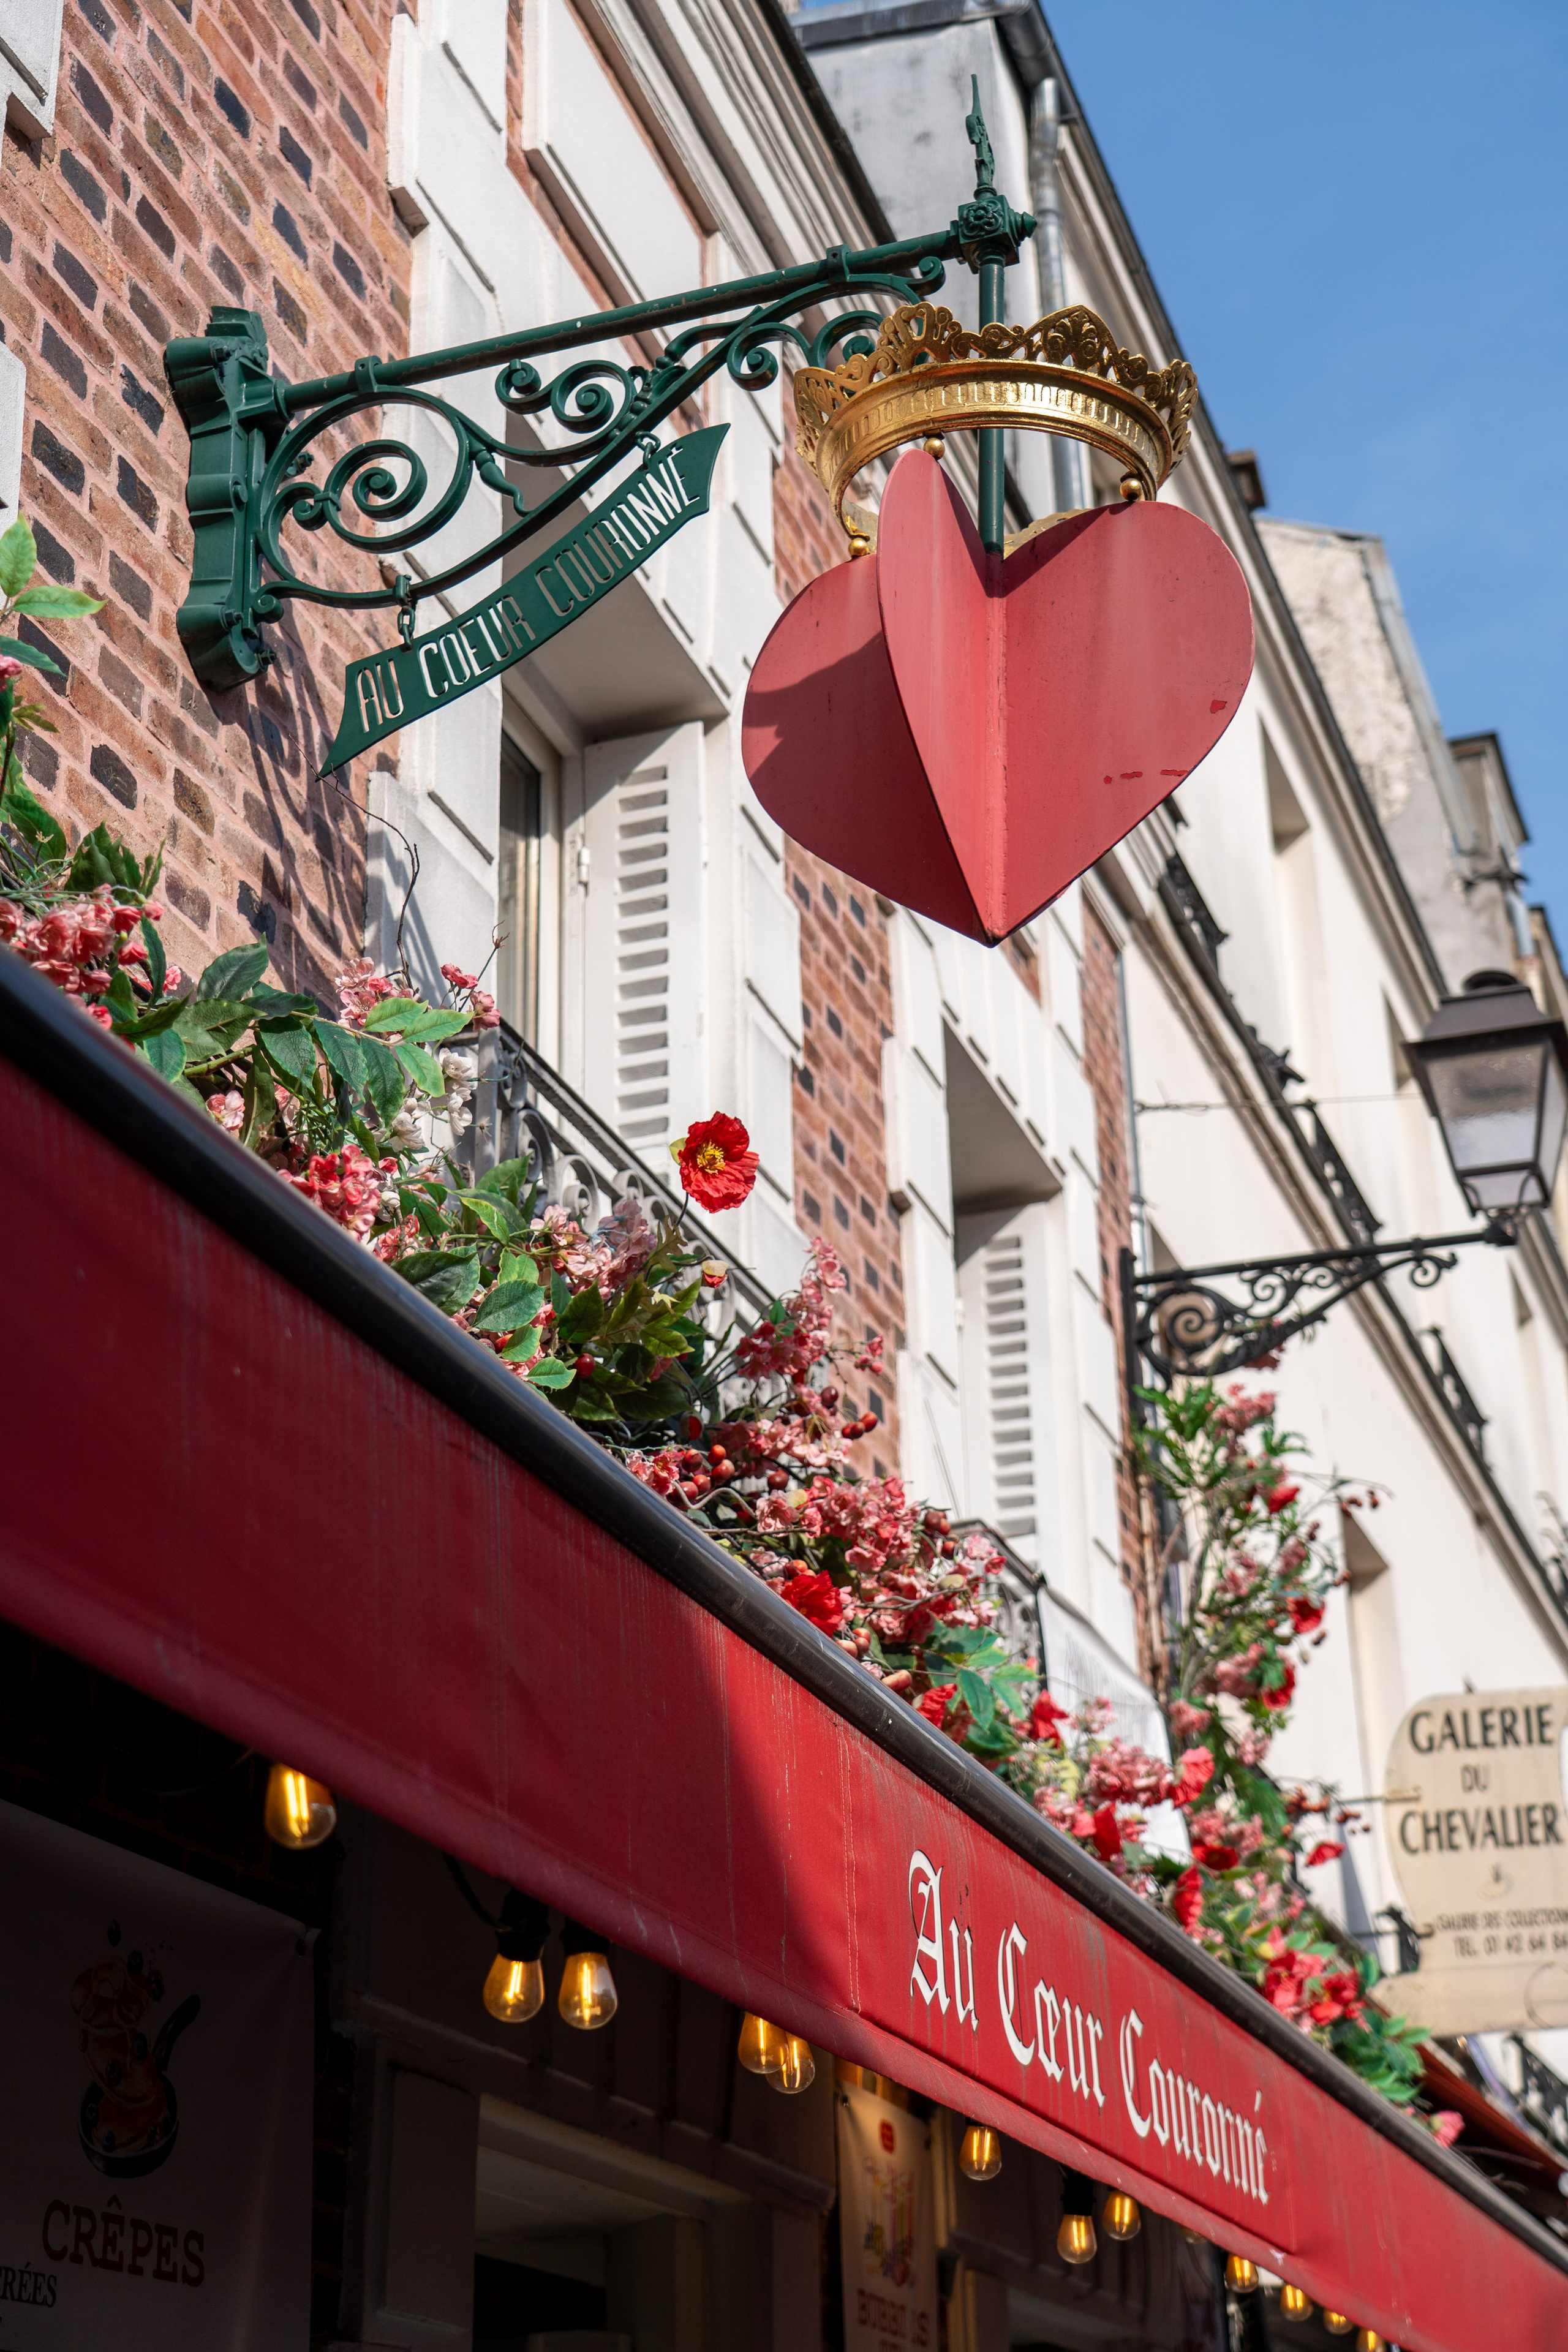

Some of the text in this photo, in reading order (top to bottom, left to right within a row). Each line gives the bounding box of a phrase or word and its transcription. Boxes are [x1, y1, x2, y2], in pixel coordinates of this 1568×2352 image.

[355, 658, 404, 733] AU
[418, 595, 536, 698] COEUR
[1409, 1703, 1555, 1754] GALERIE
[1461, 1763, 1489, 1792] DU
[1399, 1802, 1565, 1855] CHEVALIER
[908, 1849, 979, 2032] Au
[1119, 2007, 1270, 2206] Couronné
[42, 2193, 205, 2287] CRÊPES
[0, 2262, 56, 2307] RÉES
